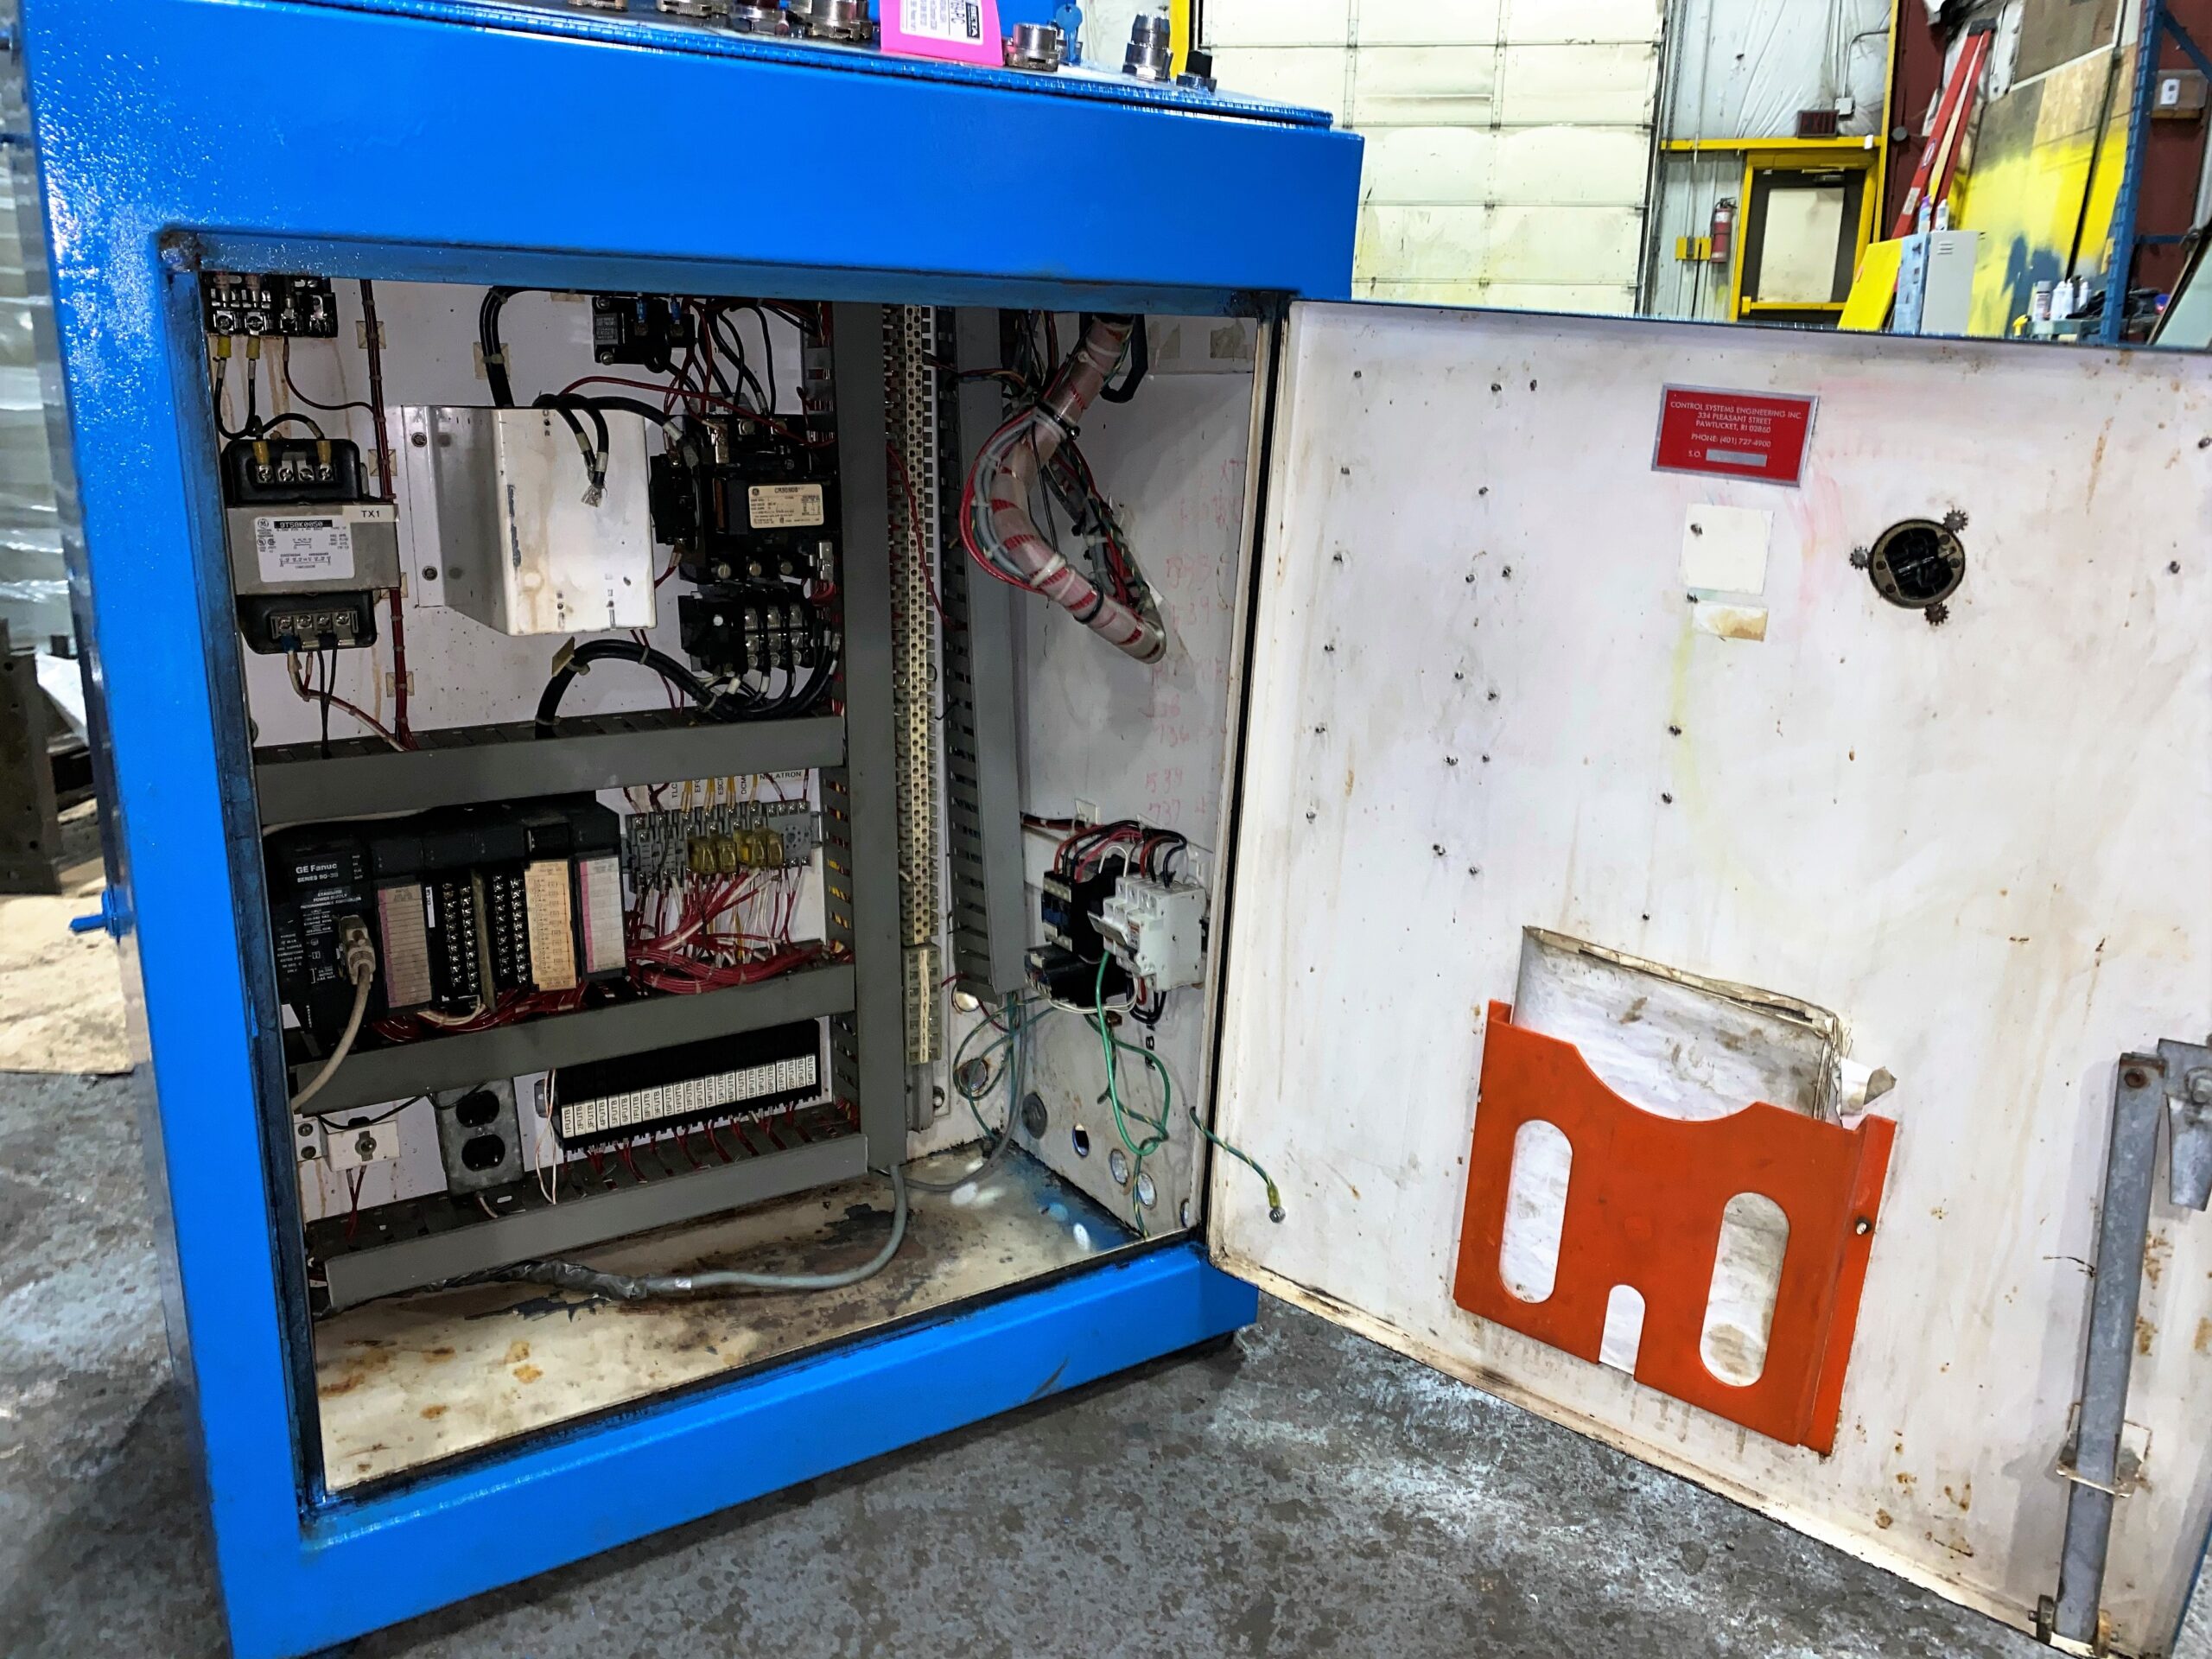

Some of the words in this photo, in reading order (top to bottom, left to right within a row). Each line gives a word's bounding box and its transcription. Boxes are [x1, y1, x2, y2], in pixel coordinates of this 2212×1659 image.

[1670, 401, 1704, 411] CONTROL
[1705, 404, 1734, 414] SYSTEMS
[1736, 407, 1786, 418] ENGINEERING
[1713, 413, 1747, 423] PLEASANT
[1748, 416, 1772, 426] STREET
[1695, 420, 1738, 432] PAWTUCKET,
[1749, 425, 1771, 434] 02860
[1719, 436, 1738, 446] (401)
[310, 863, 338, 872] Fanuc
[611, 1099, 620, 1124] 5FUTB
